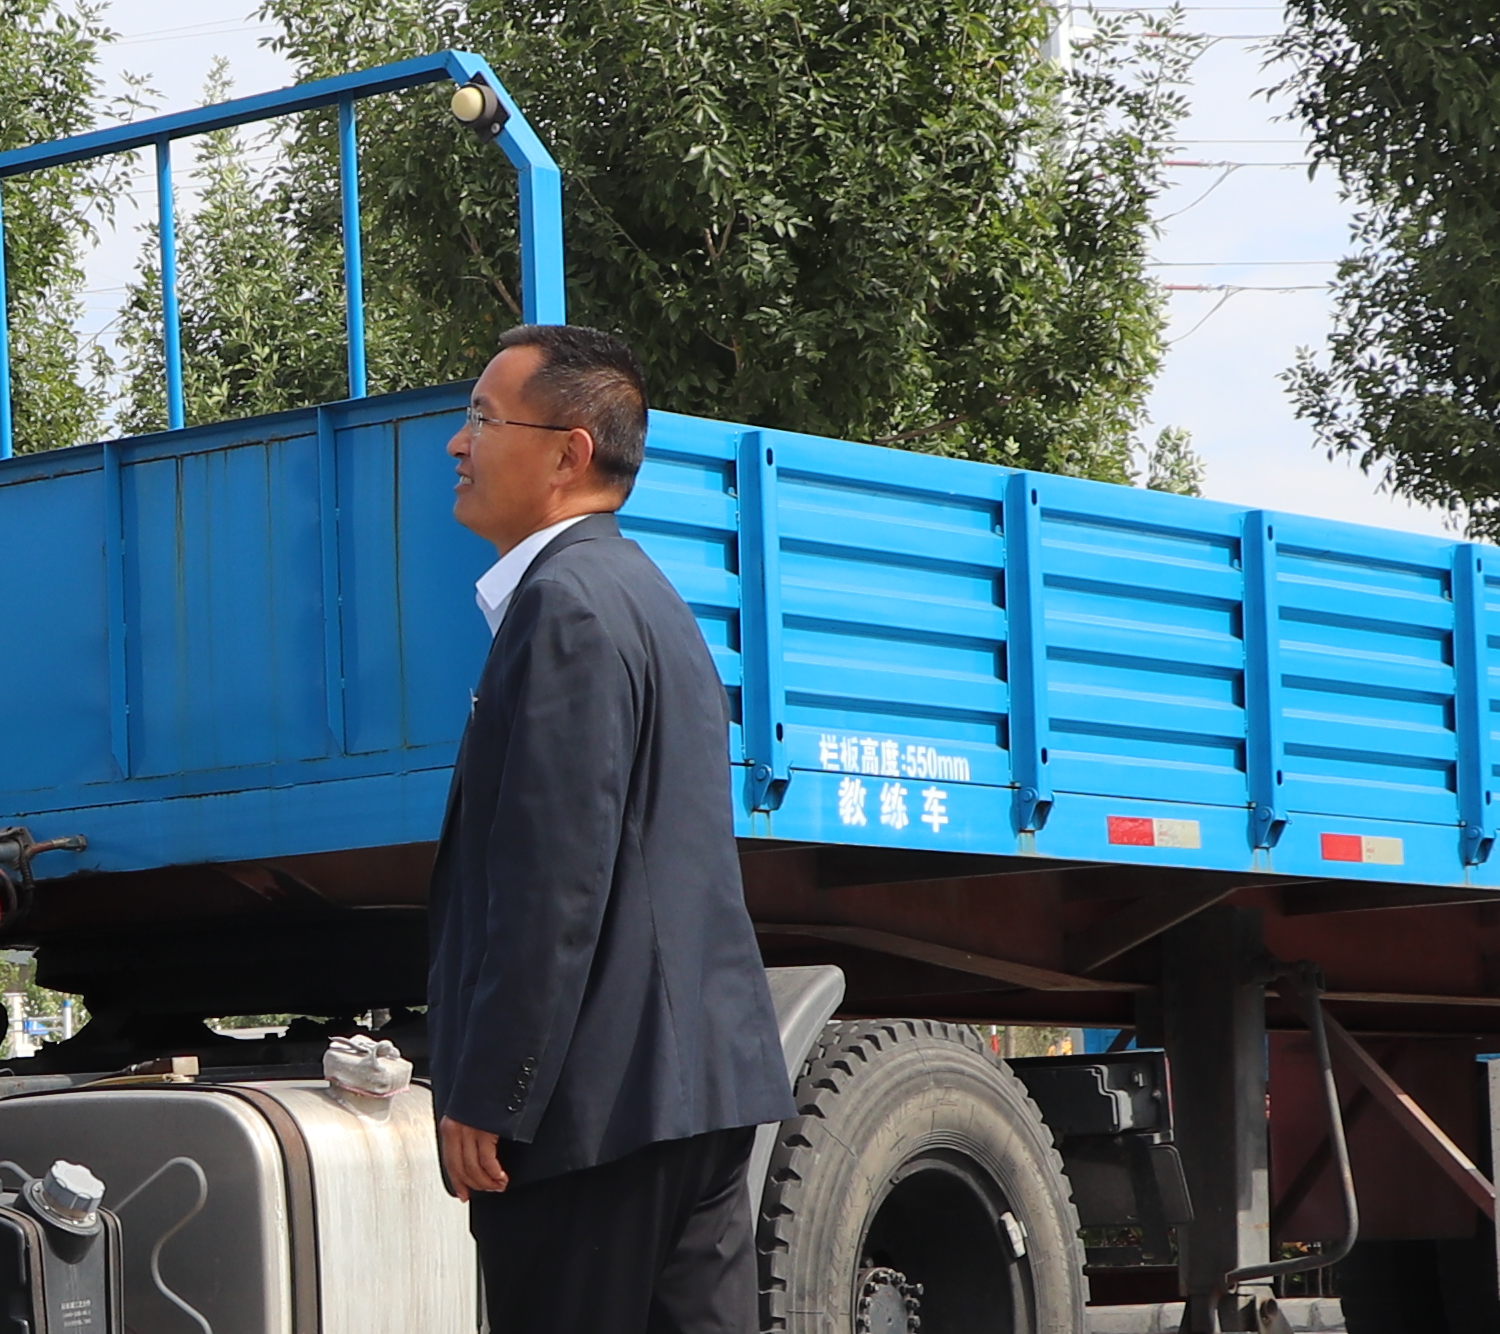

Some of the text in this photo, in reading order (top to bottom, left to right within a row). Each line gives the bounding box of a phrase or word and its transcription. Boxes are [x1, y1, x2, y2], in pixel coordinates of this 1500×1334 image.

[818, 732, 971, 782] 栏板高度:550mm
[837, 775, 950, 834] 教练车
